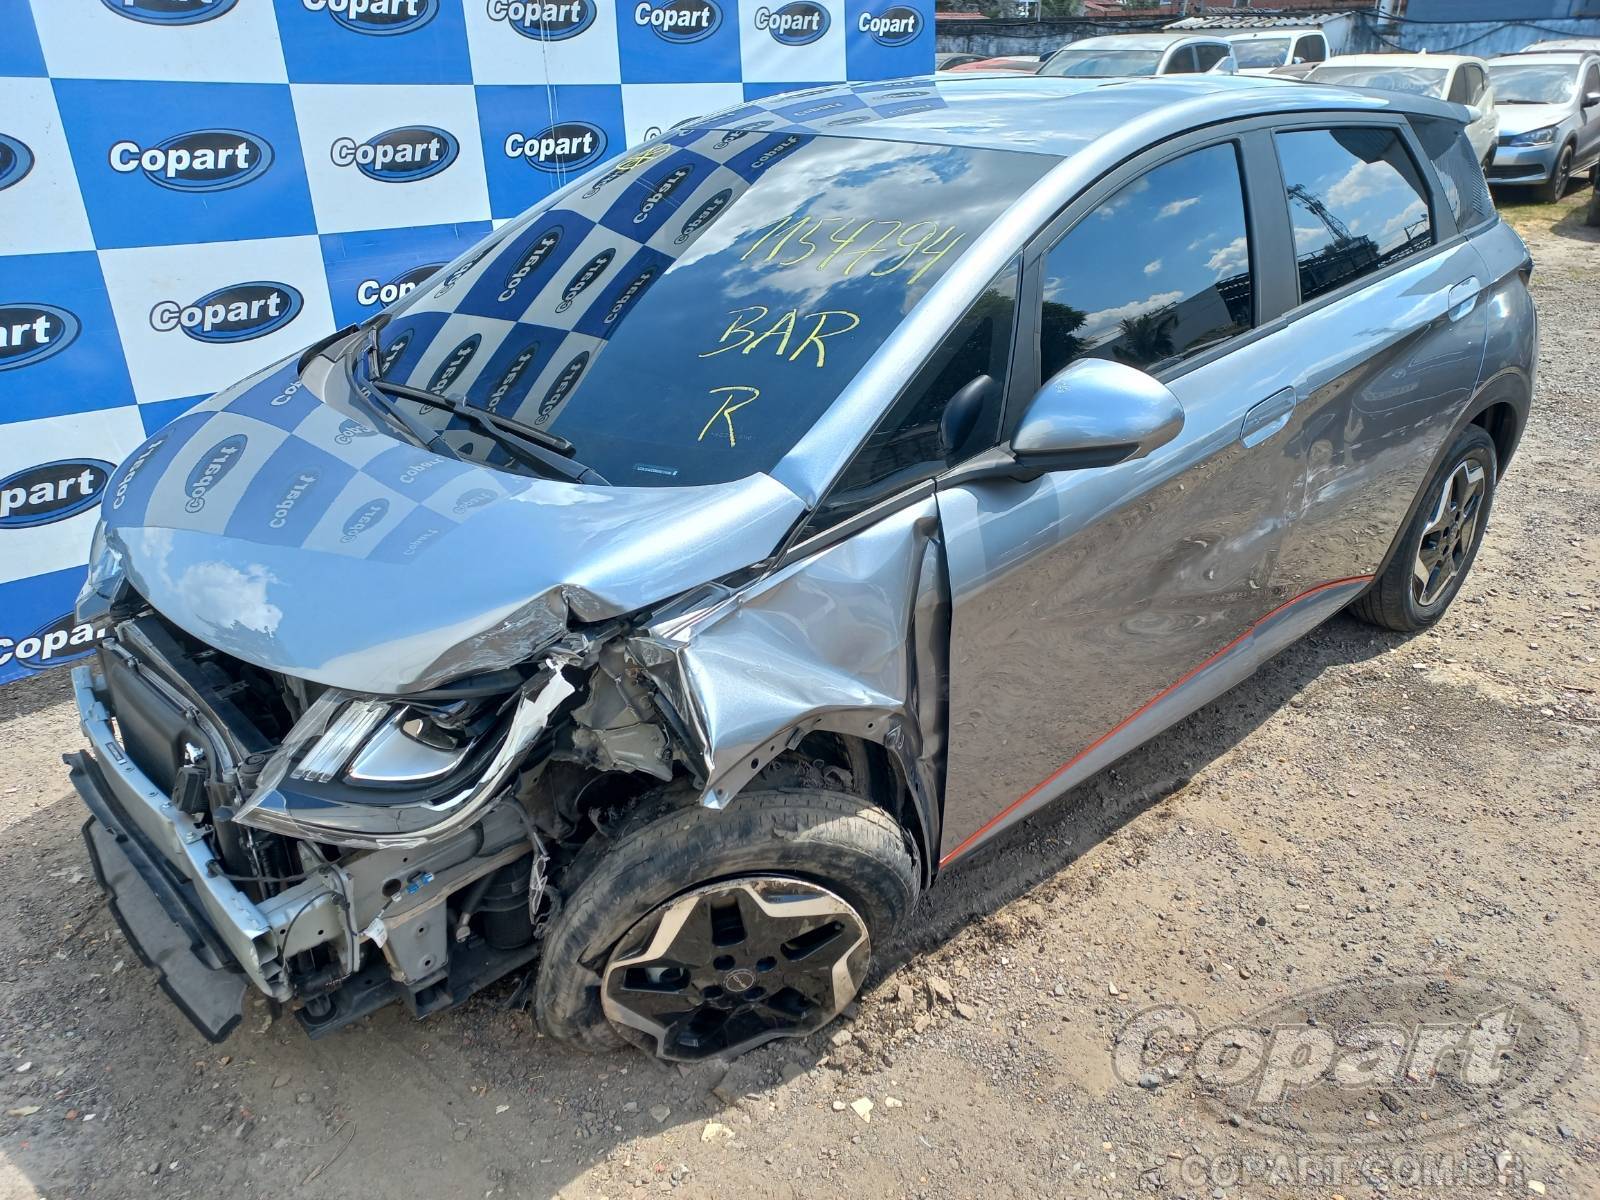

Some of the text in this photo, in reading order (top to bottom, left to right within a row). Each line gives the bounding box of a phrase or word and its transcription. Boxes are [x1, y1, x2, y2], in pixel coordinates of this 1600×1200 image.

[487, 0, 581, 26] Copart
[634, 3, 710, 32] Copart
[755, 7, 820, 35] Copart
[858, 12, 915, 37] Copart
[109, 141, 250, 179] Copart
[332, 137, 441, 170] Copart
[504, 131, 593, 163] Copart
[740, 214, 966, 285] 1154794
[357, 279, 416, 306] Cop
[150, 291, 281, 332] Copart
[698, 305, 861, 368] BAR
[698, 386, 760, 448] R
[0, 468, 95, 518] part
